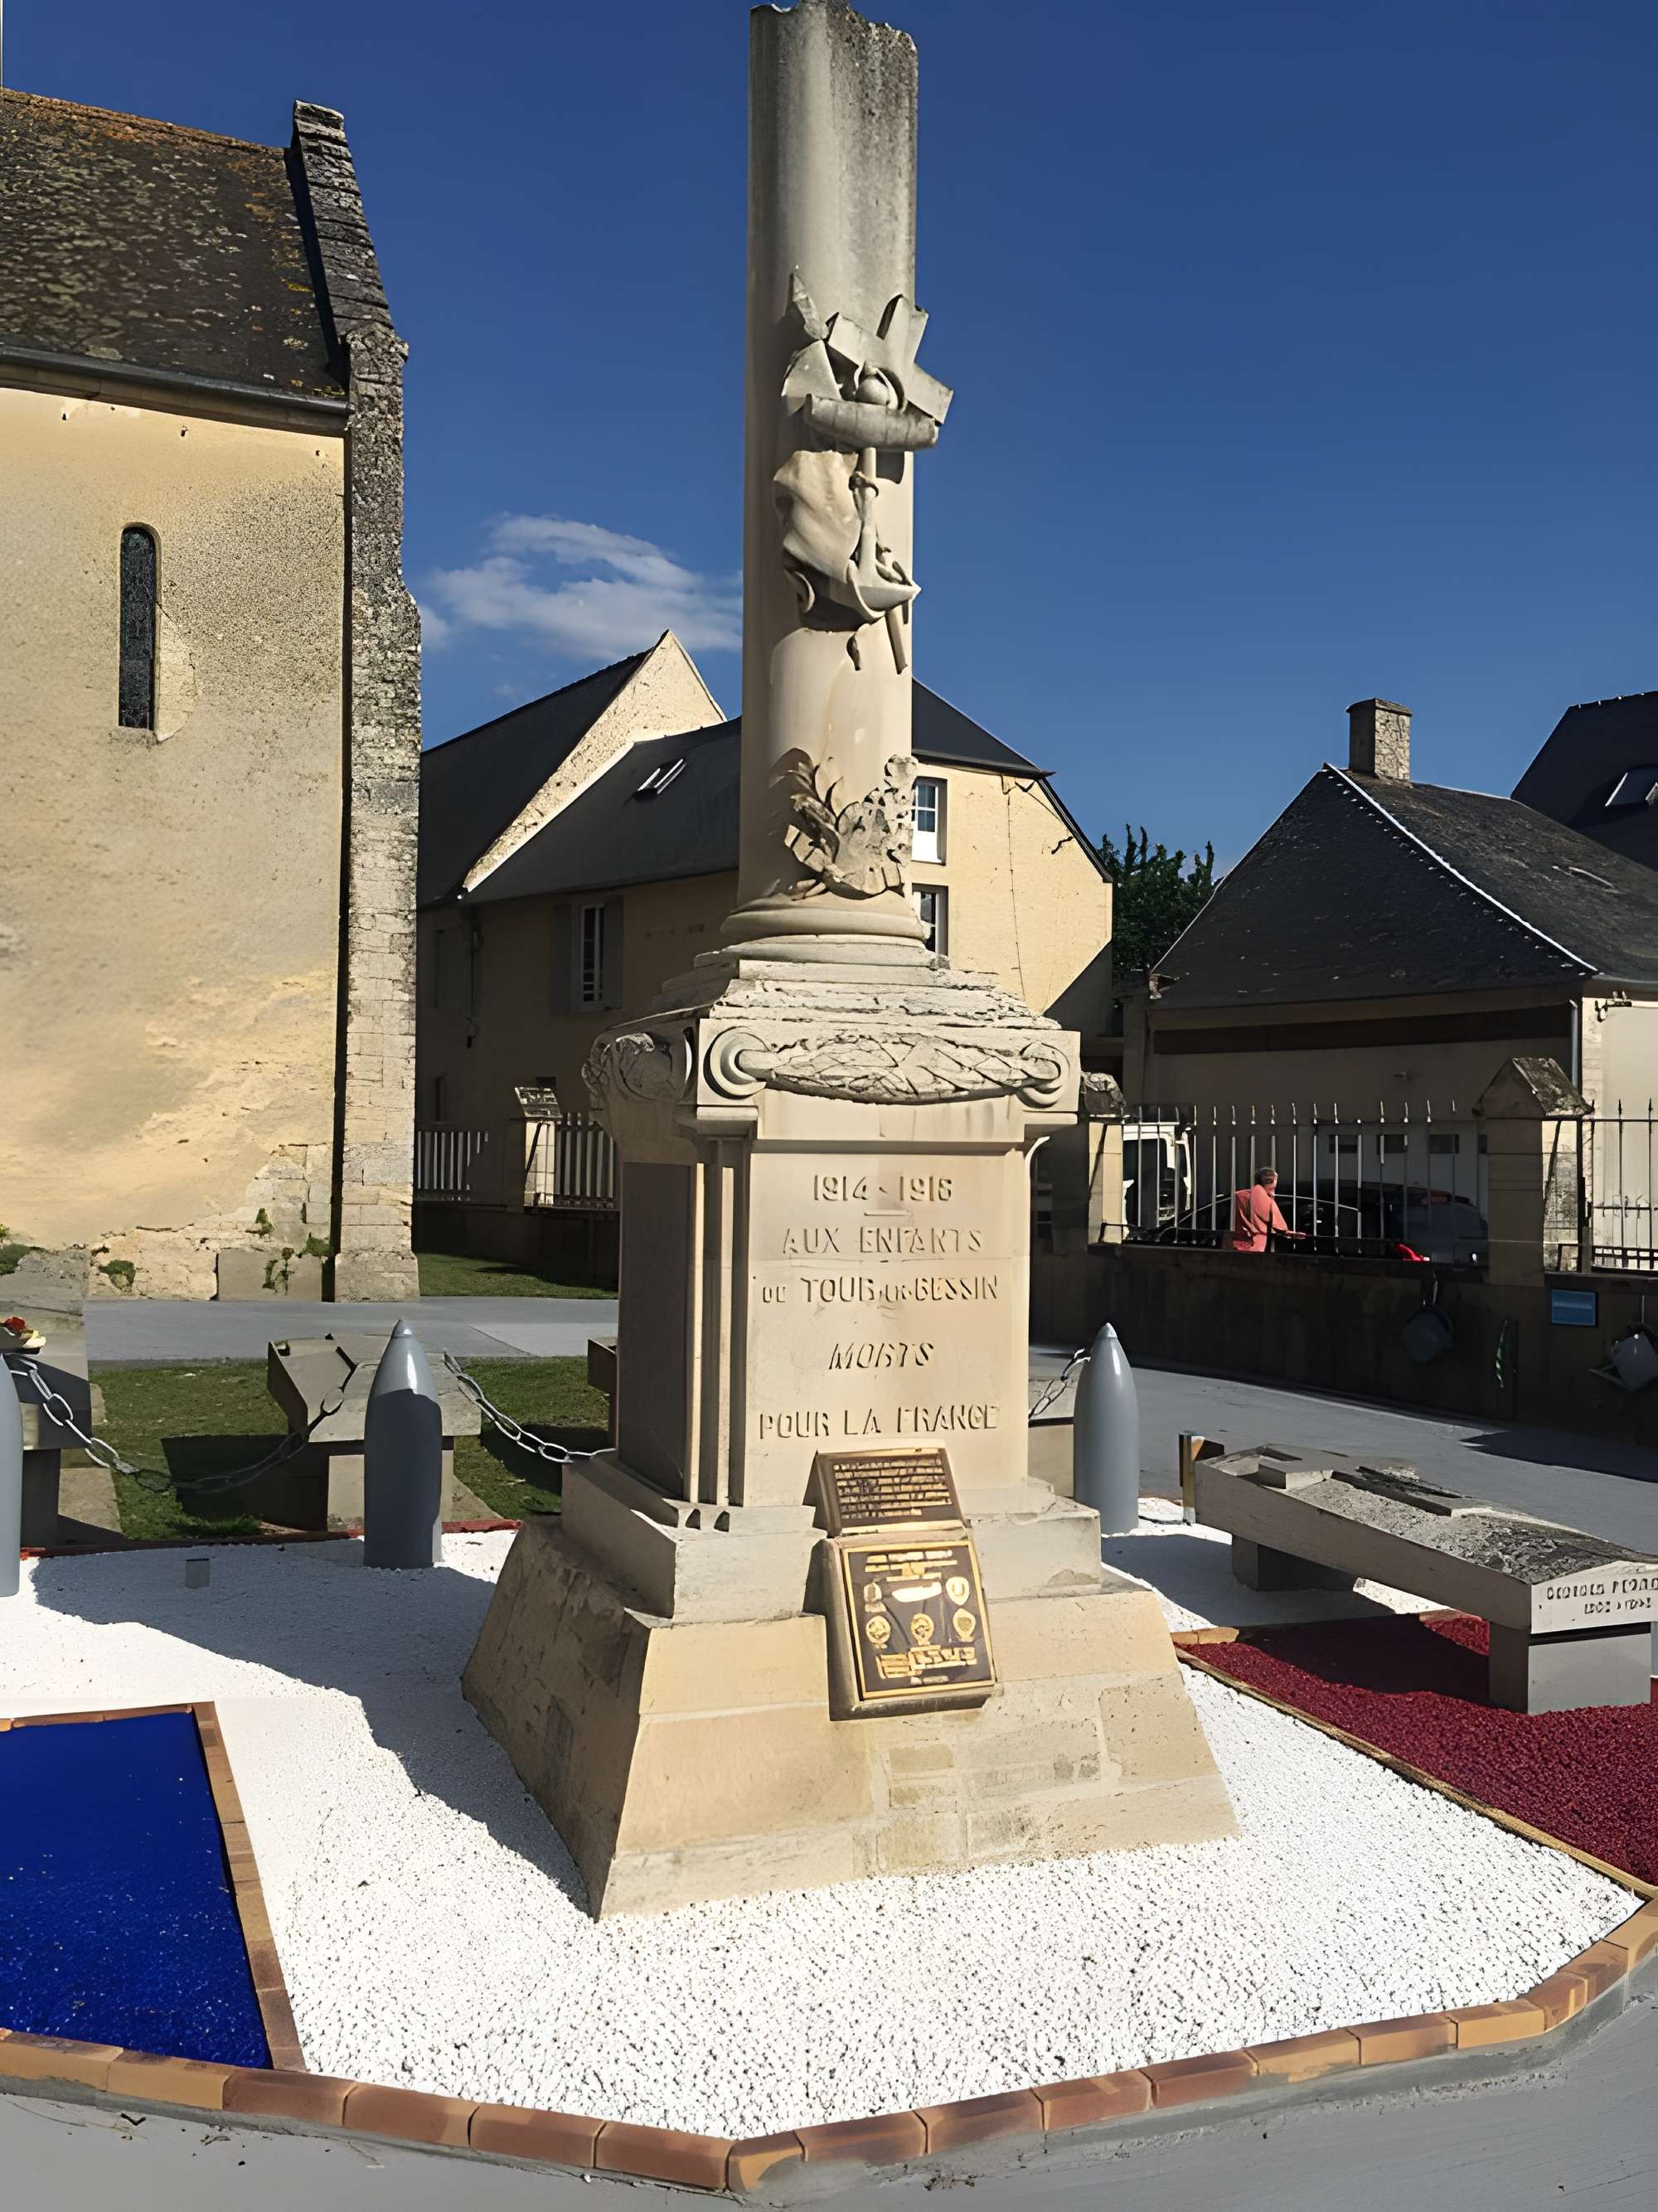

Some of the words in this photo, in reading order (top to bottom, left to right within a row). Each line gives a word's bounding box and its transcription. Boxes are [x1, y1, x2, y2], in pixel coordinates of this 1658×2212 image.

[783, 1228, 840, 1254] AUX
[828, 1341, 934, 1370] MORTS
[759, 1411, 830, 1439] POUR
[844, 1409, 882, 1435] LA
[897, 1404, 1000, 1433] FRANCE
